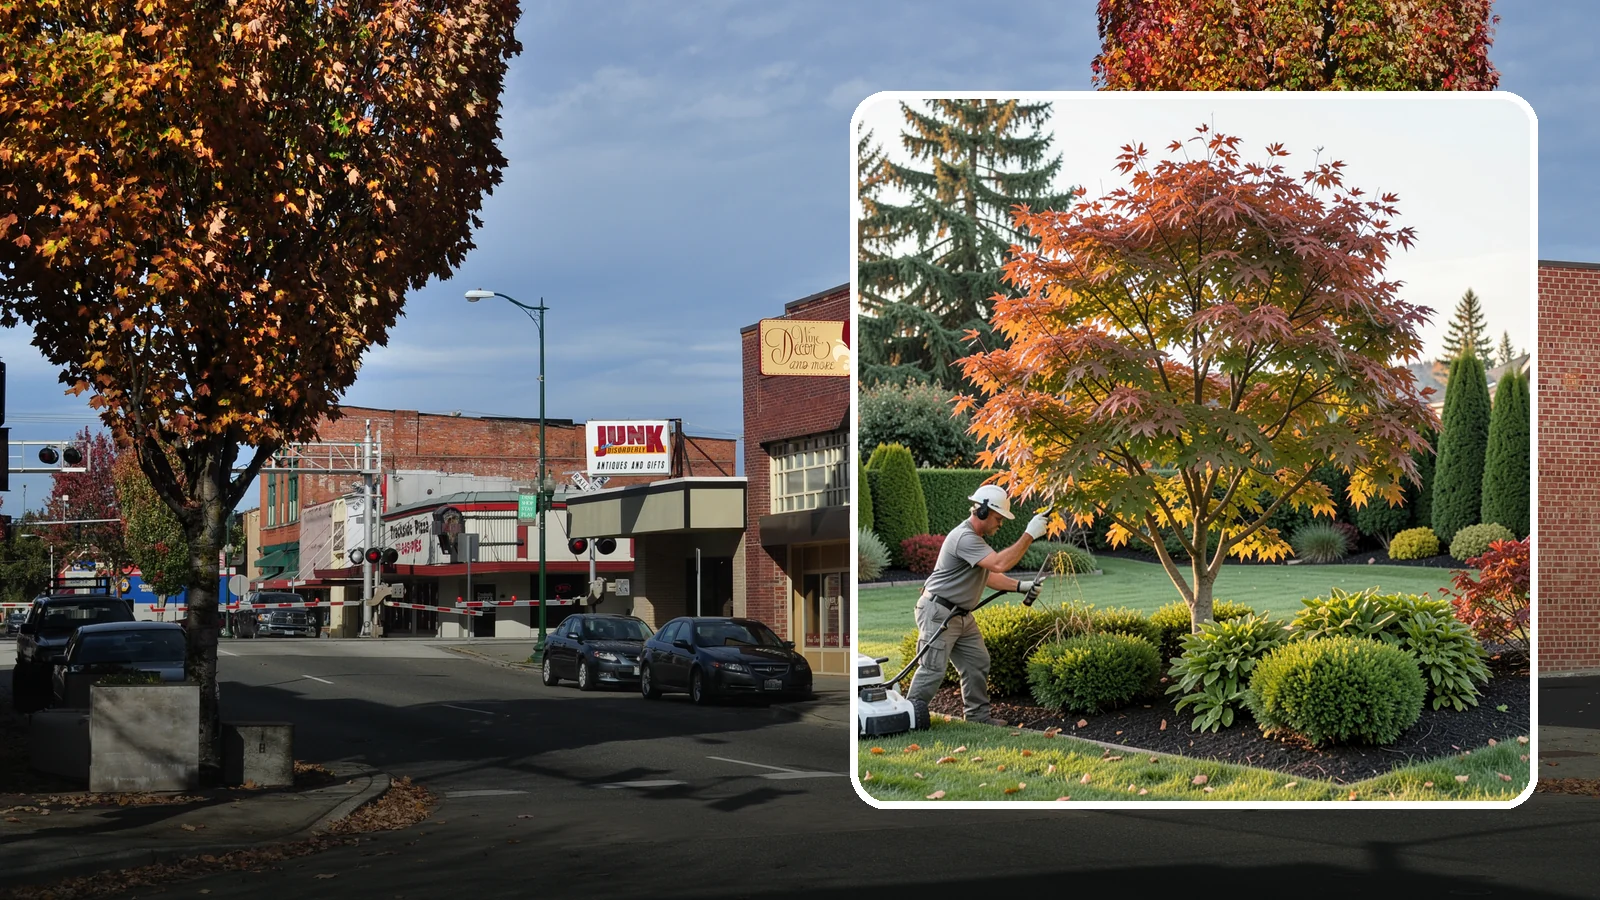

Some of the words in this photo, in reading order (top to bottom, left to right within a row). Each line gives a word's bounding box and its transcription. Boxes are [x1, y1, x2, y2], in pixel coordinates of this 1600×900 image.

[595, 426, 665, 457] JUNK
[607, 446, 646, 454] DISORDERLY
[596, 461, 628, 470] ANTIQUES
[631, 461, 644, 470] AND
[647, 460, 665, 469] GIFTS
[390, 521, 413, 539] Trackside
[414, 519, 429, 535] Pizza
